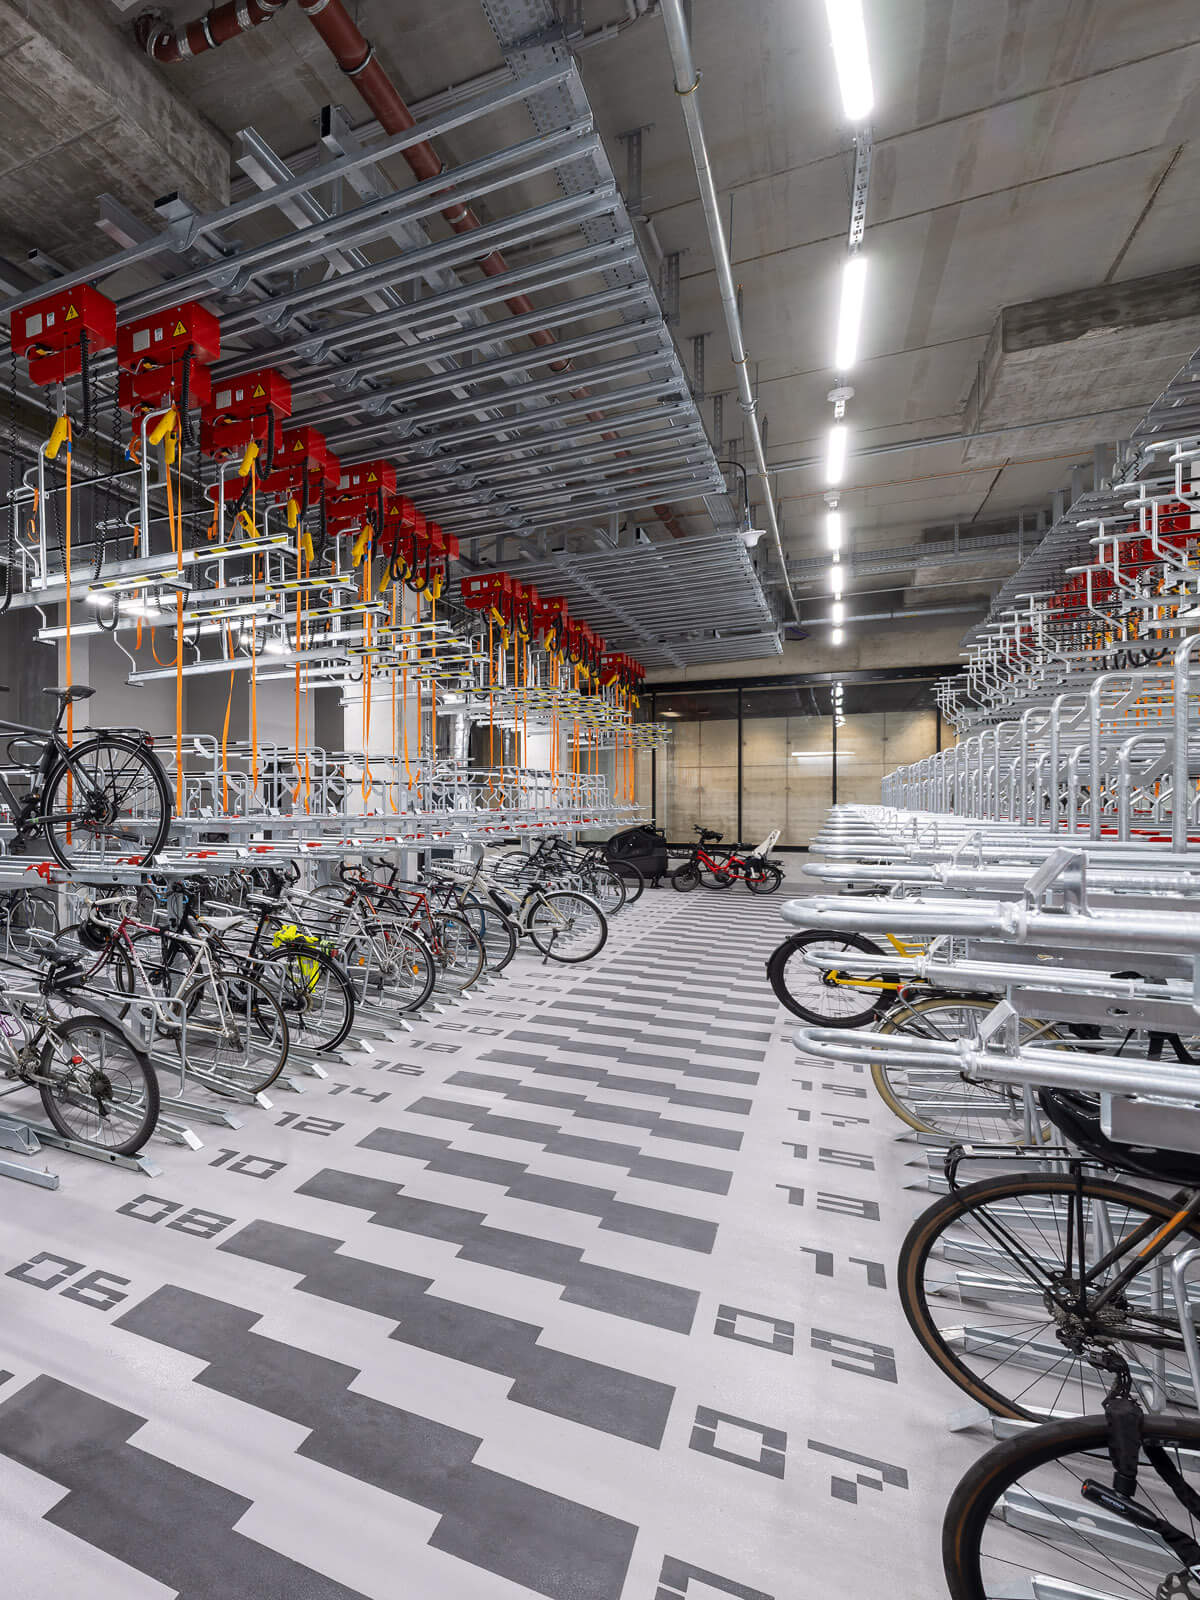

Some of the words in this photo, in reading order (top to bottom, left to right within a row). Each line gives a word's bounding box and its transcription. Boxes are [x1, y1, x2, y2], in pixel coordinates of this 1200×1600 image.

[485, 995, 546, 1006] 24
[461, 1008, 527, 1020] 22
[434, 1022, 504, 1036] 20
[409, 1040, 462, 1053] 18
[371, 1060, 425, 1076] 16
[794, 1056, 864, 1073] 21
[328, 1083, 392, 1103] 14
[791, 1078, 868, 1099] 19
[274, 1111, 345, 1136] 12
[787, 1107, 870, 1128] 17
[208, 1148, 288, 1179] 10
[781, 1141, 875, 1171] 15
[775, 1183, 881, 1221] 13
[116, 1194, 236, 1239] 08
[800, 1246, 887, 1289] 11
[5, 1251, 130, 1311] 06
[713, 1303, 898, 1384] 09
[688, 1404, 909, 1504] 07
